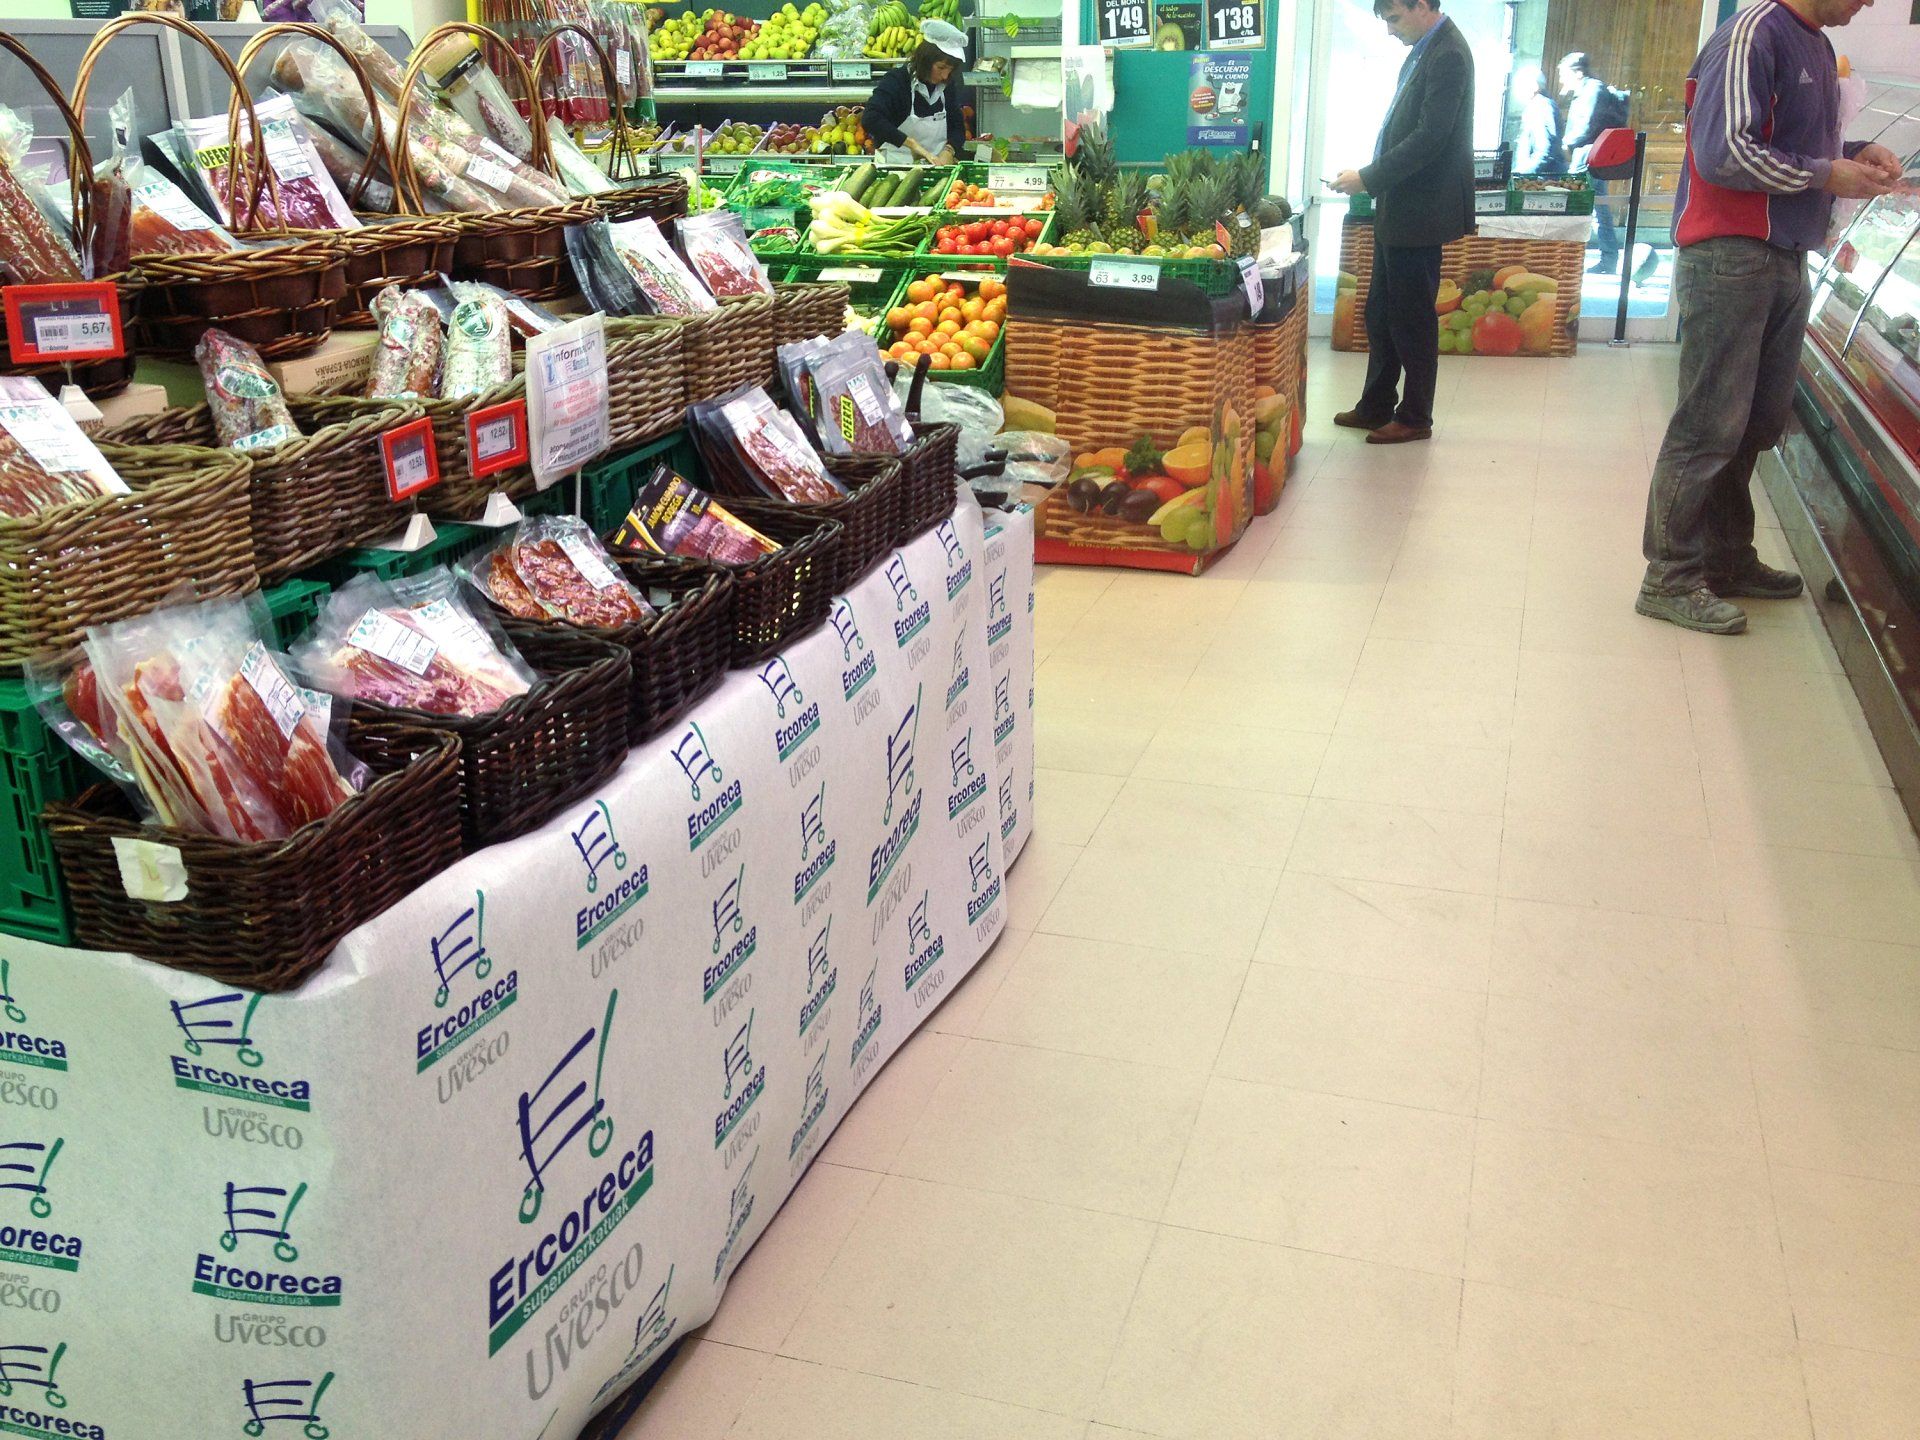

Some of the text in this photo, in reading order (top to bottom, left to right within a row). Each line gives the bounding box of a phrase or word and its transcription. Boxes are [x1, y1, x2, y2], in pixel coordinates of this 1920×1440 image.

[1105, 6, 1143, 37] 1'49
[1106, 0, 1120, 8] DEL
[1214, 6, 1254, 38] 1'38
[1204, 65, 1249, 73] DESCUENTO
[200, 145, 231, 167] OFER
[1095, 273, 1109, 284] 63
[843, 400, 853, 439] OFERTA
[661, 494, 685, 524] BODEGA
[946, 559, 972, 592] Ercoreca
[894, 600, 930, 640] Ercoreca
[842, 649, 876, 692] Ercoreca
[775, 702, 819, 753] Ercoreca
[789, 744, 821, 789] Uvesco
[688, 779, 742, 840] Ercoreca
[948, 772, 986, 812] Ercoreca
[869, 787, 922, 888] Ercoreca
[956, 805, 986, 839] Uvesco
[702, 827, 741, 879] Uvesco
[794, 839, 836, 894] Ercoreca
[577, 863, 648, 938] Ercoreca
[967, 875, 1000, 917] Ercoreca
[591, 918, 644, 979] Uvesco
[704, 925, 756, 993] Ercoreca
[904, 935, 943, 983] Ercoreca
[799, 966, 838, 1029] Ercoreca
[913, 969, 945, 1009] Uvesco
[417, 970, 517, 1060] Ercoreca
[170, 1055, 310, 1101] Ercoreca
[437, 1031, 509, 1104] Uvesco
[227, 1107, 268, 1122] GRUPO
[715, 1065, 765, 1139] Ercoreca
[203, 1106, 304, 1151] Uvesco
[489, 1129, 654, 1330] Ercoreca
[195, 1253, 342, 1295] Ercoreca
[522, 1196, 630, 1320] supermerkatuak
[215, 1288, 312, 1306] supermerkatuak
[559, 1263, 607, 1324] GRUPO
[215, 1313, 327, 1348] Uvesco
[242, 1312, 286, 1325] GRUPO
[526, 1242, 643, 1401] Uvesco
